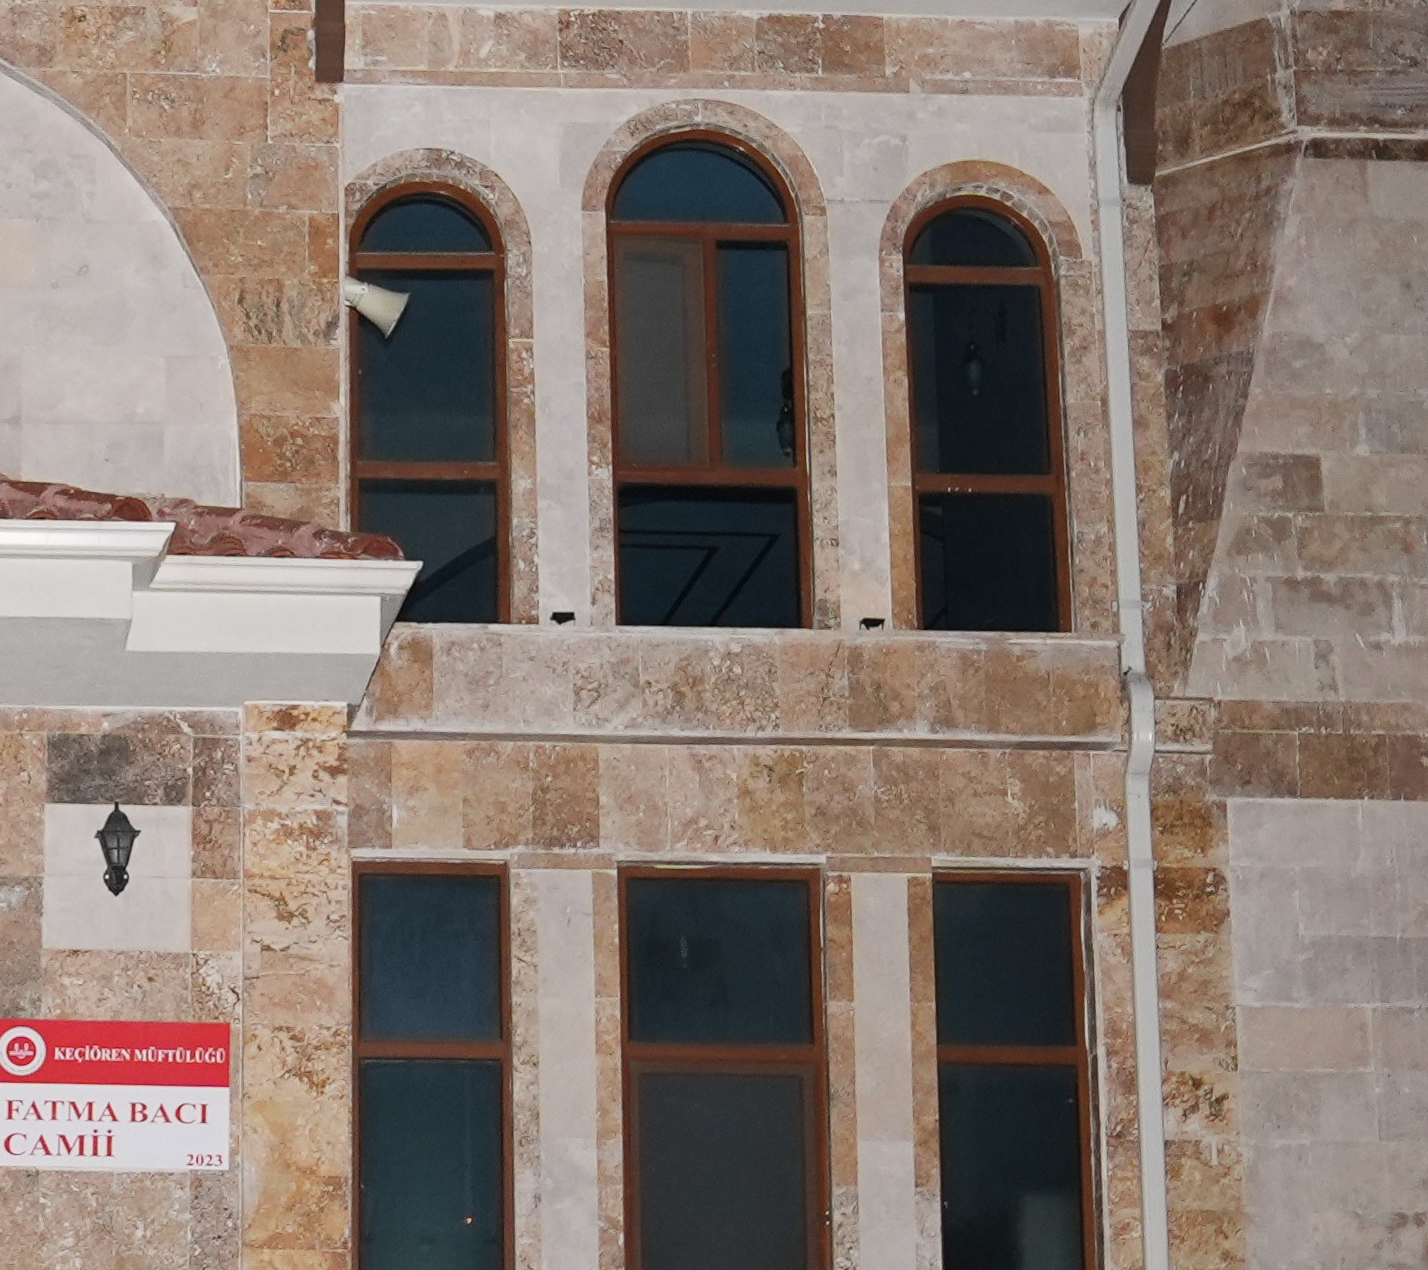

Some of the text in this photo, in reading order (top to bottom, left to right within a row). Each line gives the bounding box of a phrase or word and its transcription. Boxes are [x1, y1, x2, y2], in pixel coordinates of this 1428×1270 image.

[54, 1045, 226, 1063] KEÇİÖREN MÜFTÜLÜĞÜ
[6, 1099, 209, 1124] FATMA BACI
[4, 1129, 115, 1157] CAMİİ
[186, 1154, 223, 1166] 2023
